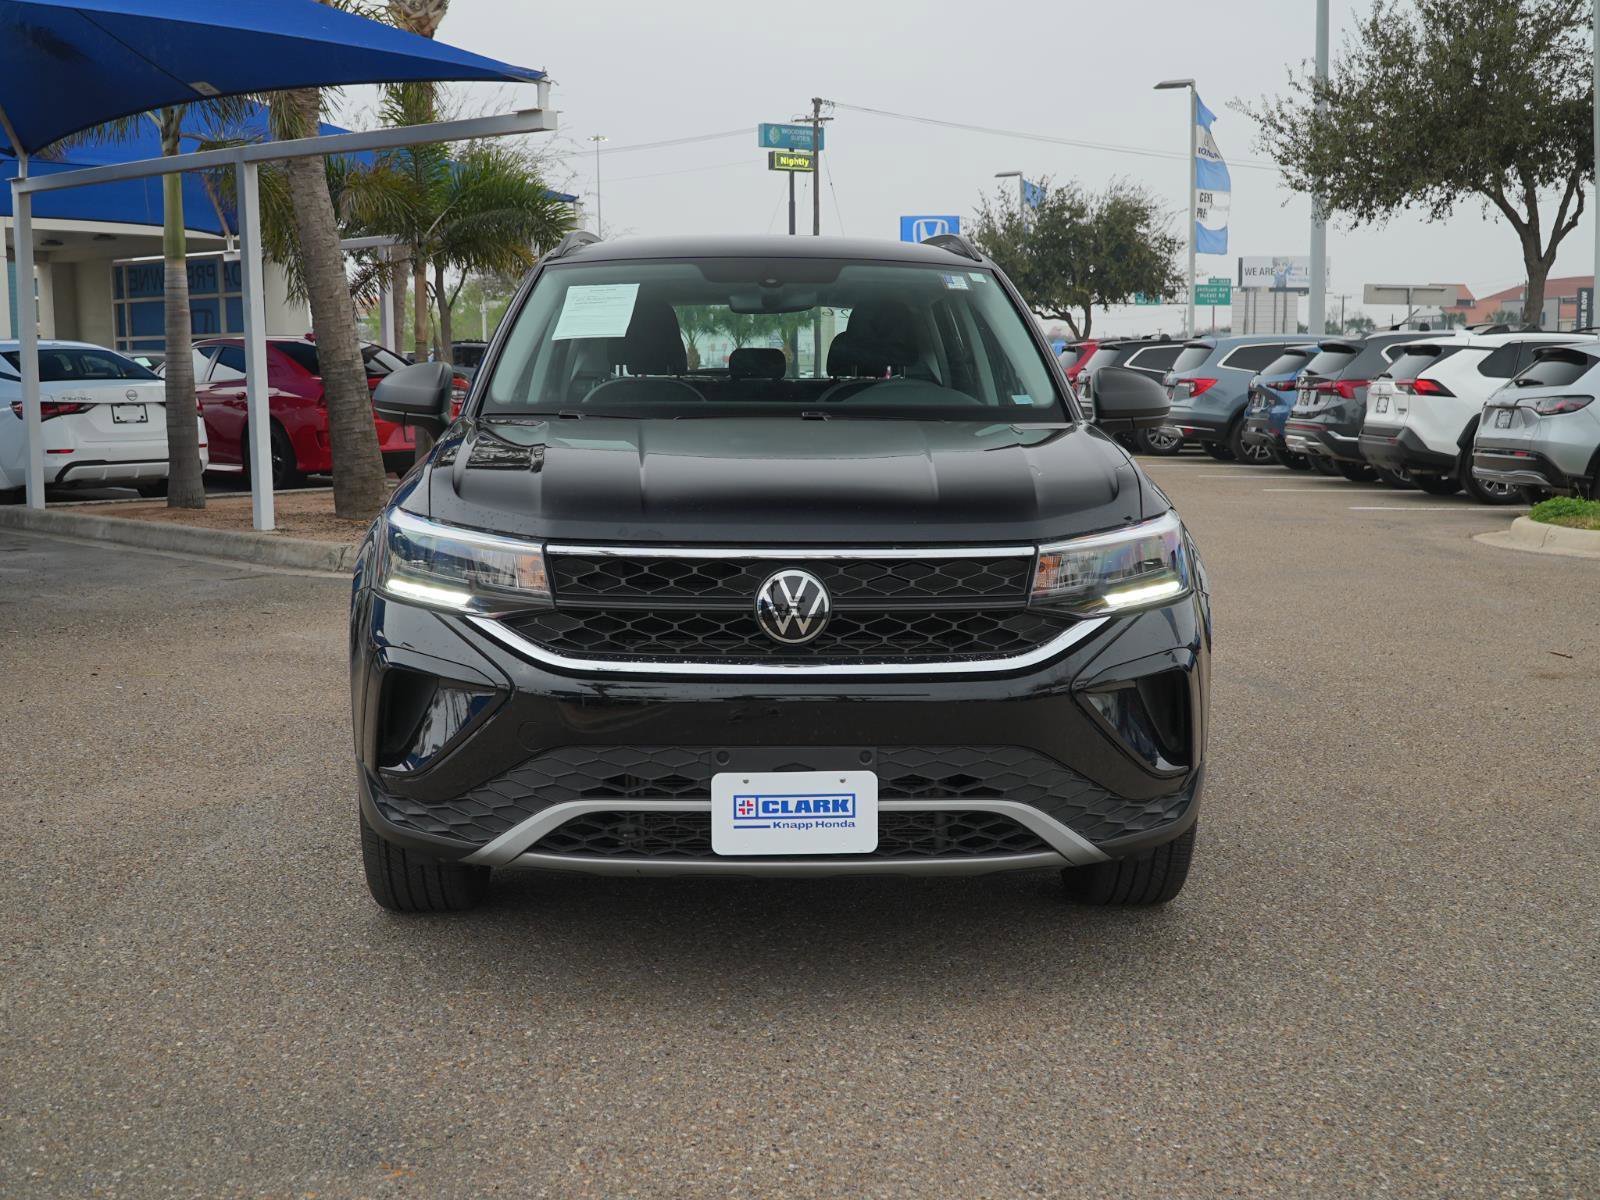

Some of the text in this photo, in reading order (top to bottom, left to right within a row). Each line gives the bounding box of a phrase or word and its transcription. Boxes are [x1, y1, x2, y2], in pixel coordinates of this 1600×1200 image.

[780, 156, 809, 167] Nightly
[1244, 267, 1257, 276] WE
[762, 799, 850, 814] CLARK
[773, 820, 856, 831] Knapp Honda
